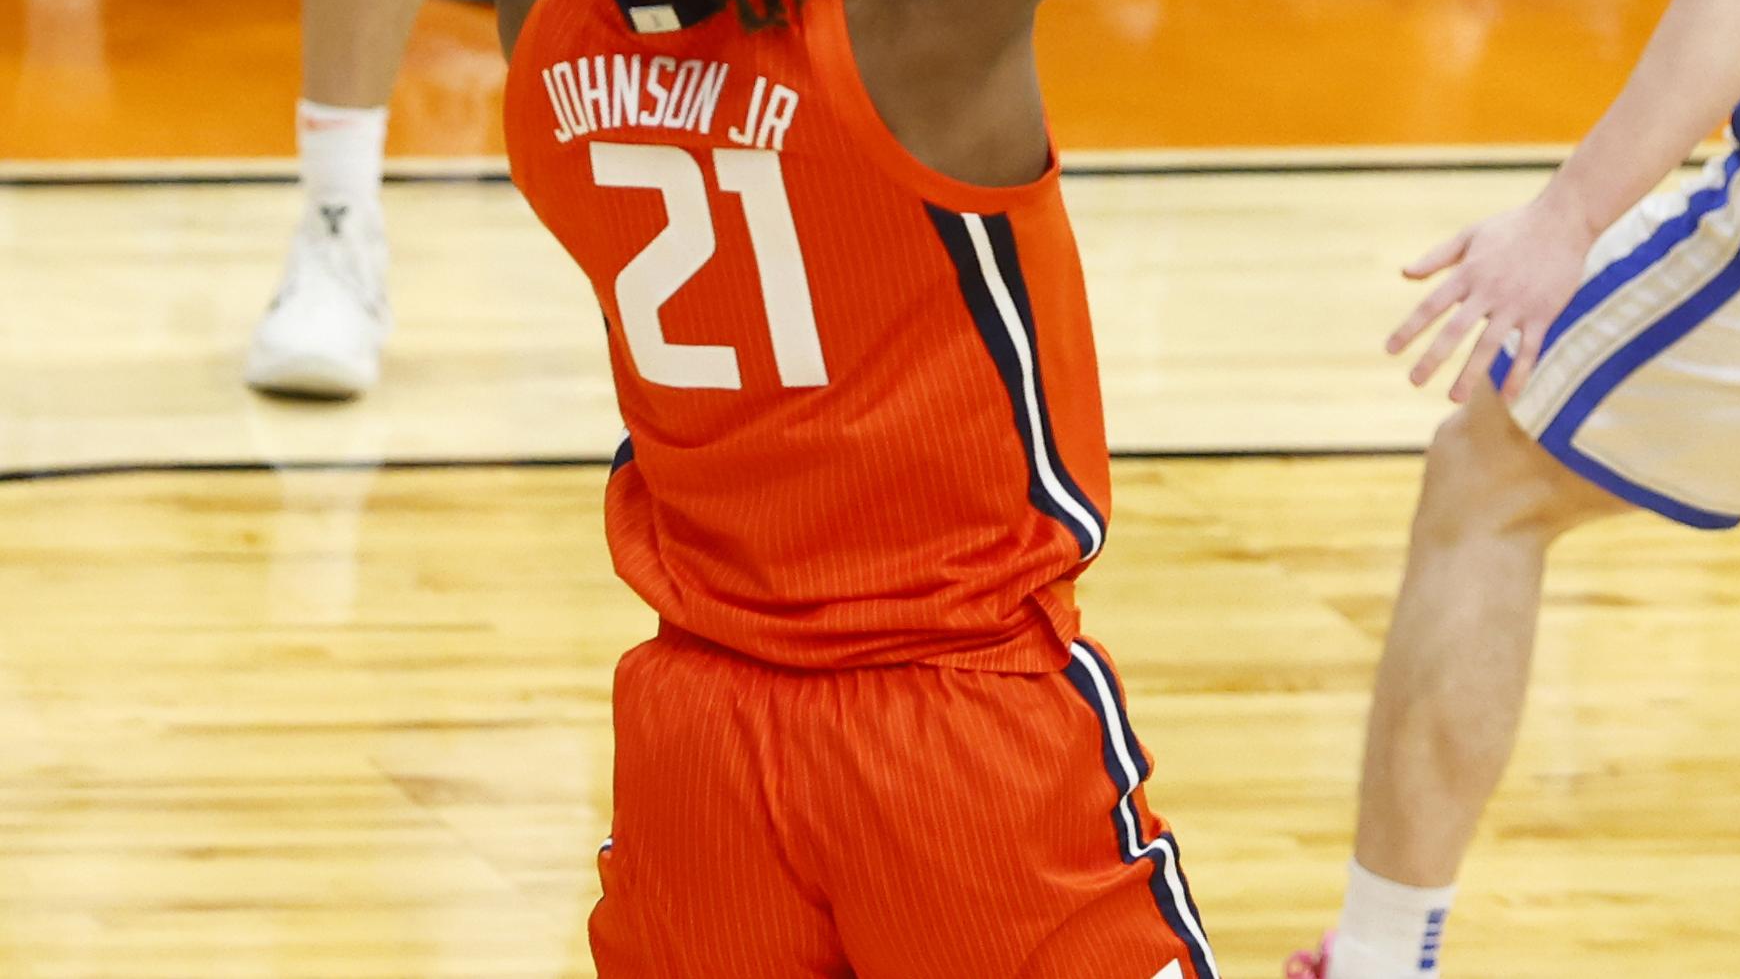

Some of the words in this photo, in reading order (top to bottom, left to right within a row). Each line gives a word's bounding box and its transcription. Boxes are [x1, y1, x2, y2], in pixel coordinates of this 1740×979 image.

[542, 53, 728, 143] JOHNSON
[727, 76, 799, 151] JR
[589, 141, 829, 390] 21
